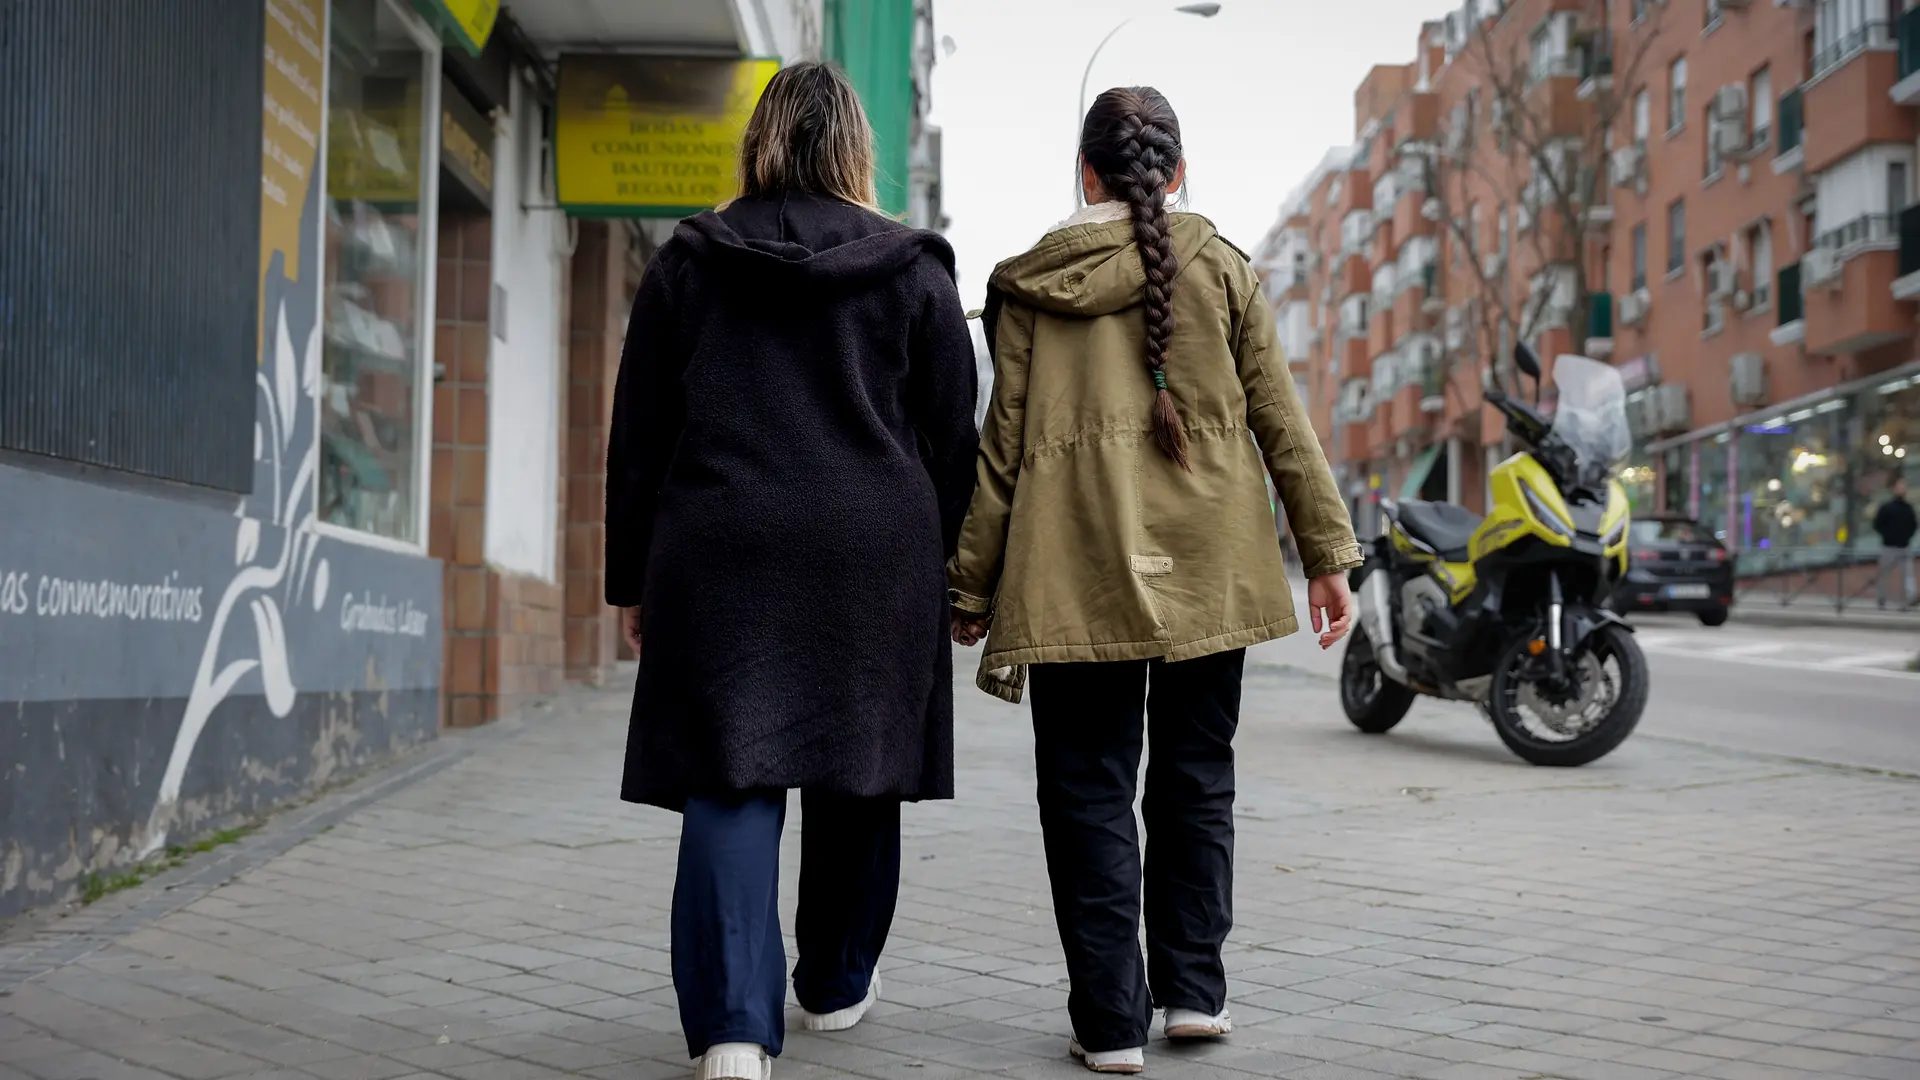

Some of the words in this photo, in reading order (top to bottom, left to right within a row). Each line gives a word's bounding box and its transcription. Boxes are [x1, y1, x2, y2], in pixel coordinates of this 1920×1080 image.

[630, 119, 704, 136] BODAS
[613, 161, 722, 177] BAUTIZOS
[617, 181, 717, 198] REGALOS
[0, 571, 29, 615] as
[36, 569, 202, 622] conmemorativas
